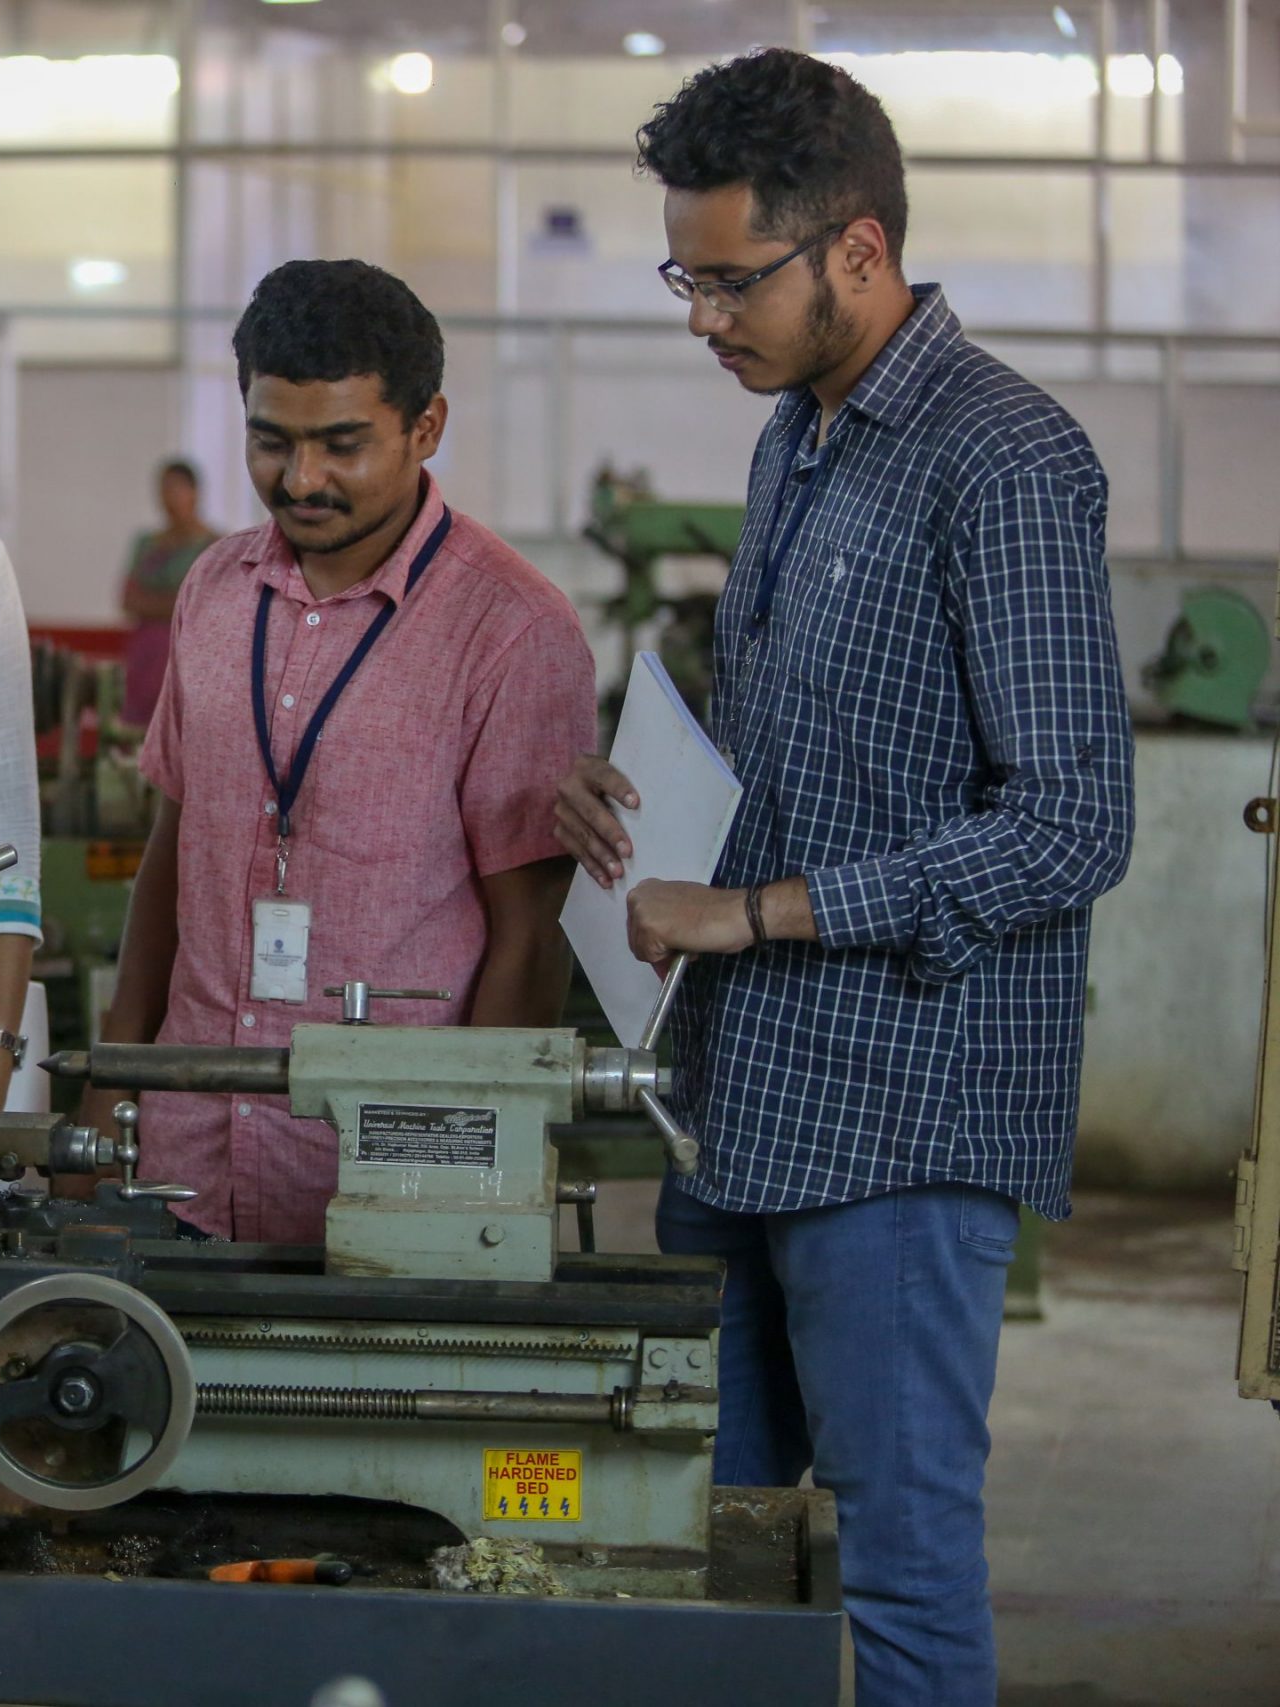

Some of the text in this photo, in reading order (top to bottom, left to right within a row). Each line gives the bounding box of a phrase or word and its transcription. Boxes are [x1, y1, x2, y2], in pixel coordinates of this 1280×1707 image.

[363, 1119, 494, 1135] Universal Machine Tools Corporation
[506, 1452, 560, 1466] FLAME
[488, 1467, 577, 1481] HARDENED
[516, 1481, 549, 1495] BED
